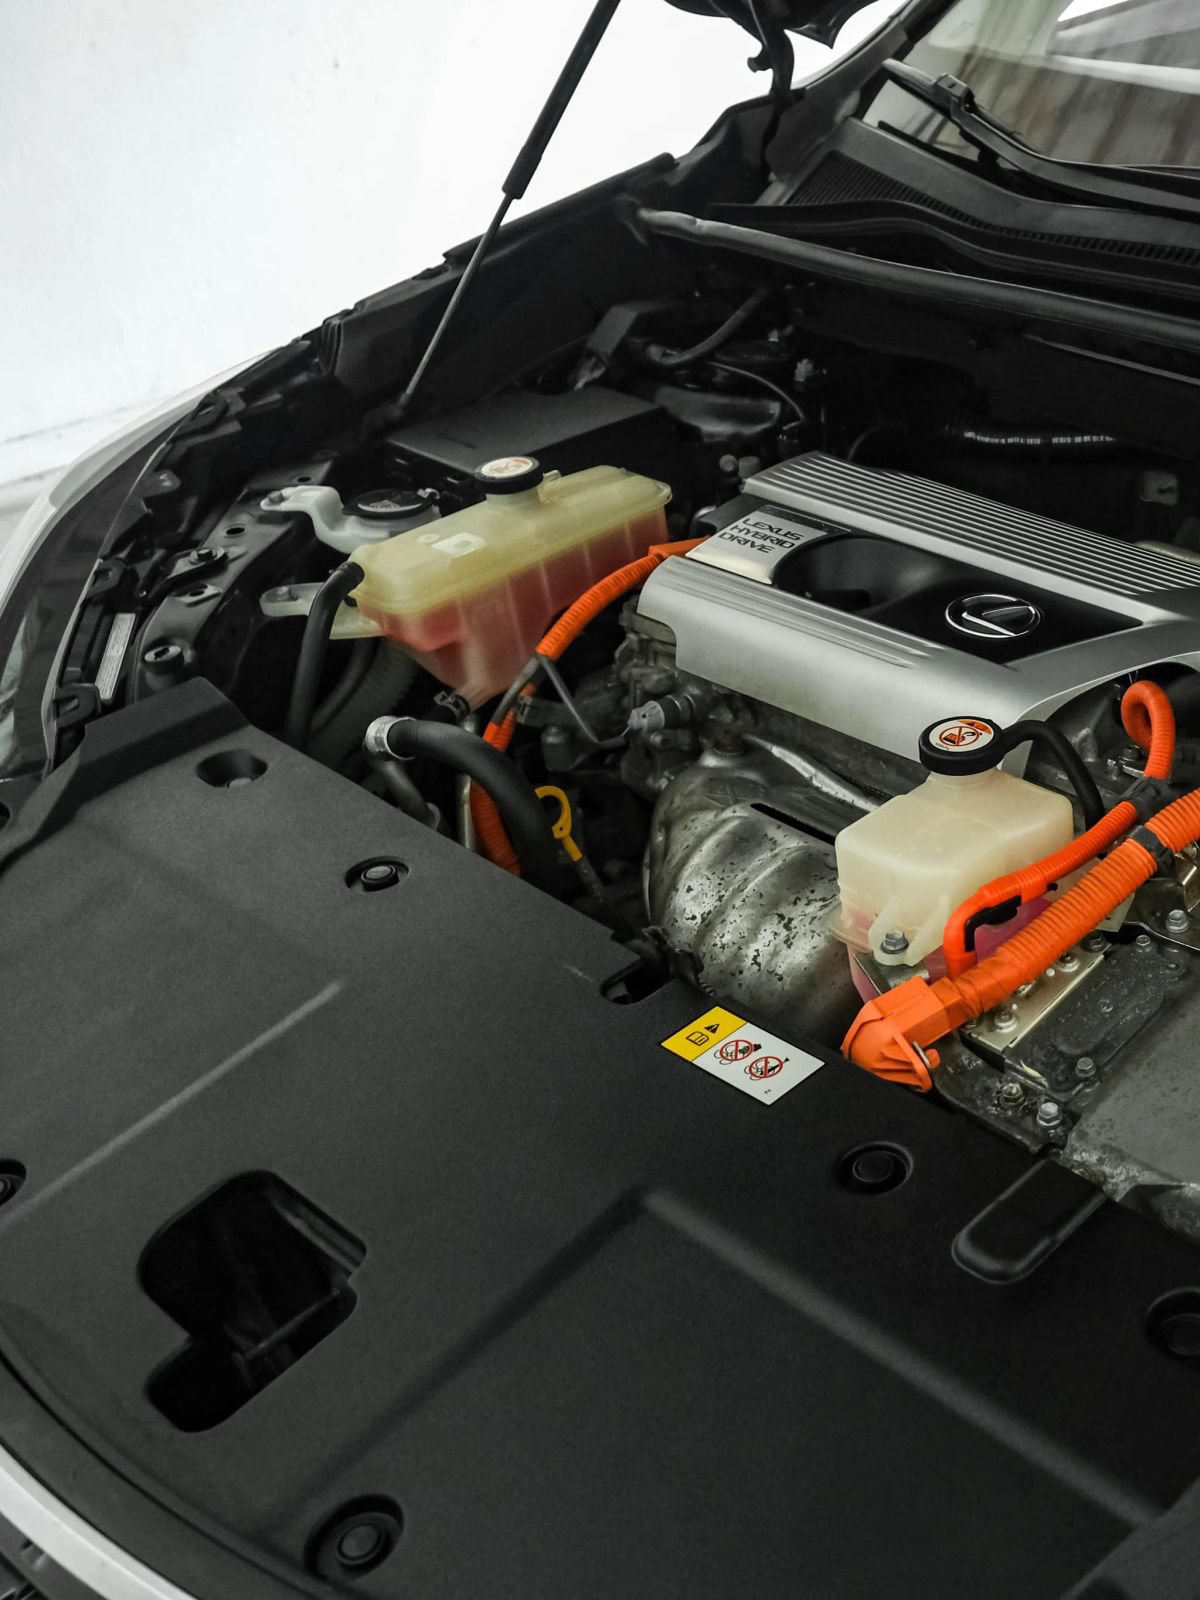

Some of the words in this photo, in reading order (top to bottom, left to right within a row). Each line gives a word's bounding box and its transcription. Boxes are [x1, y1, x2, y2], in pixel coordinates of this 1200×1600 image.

[729, 524, 795, 549] HYBRID
[742, 518, 804, 540] LEXUS
[718, 532, 775, 553] DRIVE
